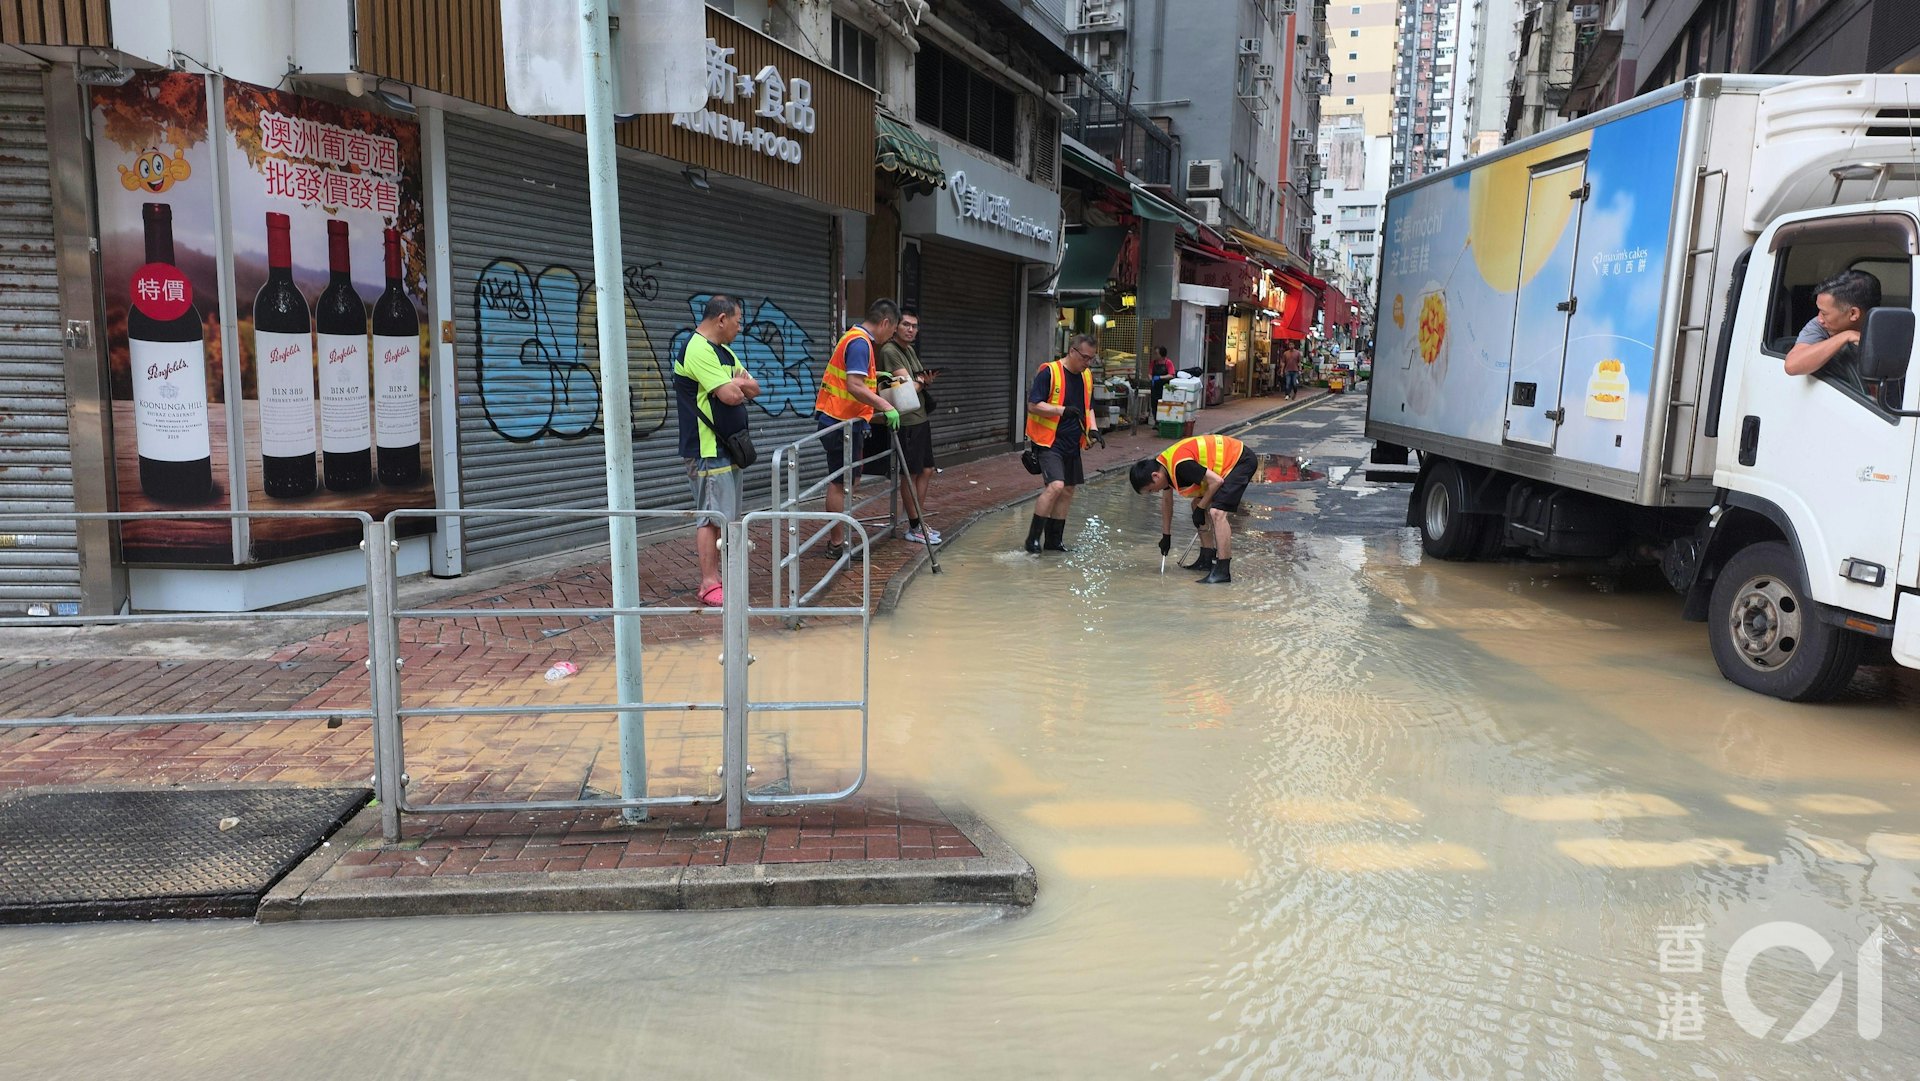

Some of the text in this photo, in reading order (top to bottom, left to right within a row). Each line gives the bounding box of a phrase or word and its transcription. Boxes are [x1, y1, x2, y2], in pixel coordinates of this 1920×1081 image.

[755, 65, 815, 134] 食品
[262, 113, 396, 173] 澳洲葡萄酒
[752, 127, 801, 165] FOOD
[266, 161, 398, 213] 批發價發售
[1628, 246, 1648, 260] cakes
[138, 278, 185, 302] 特價
[272, 388, 287, 396] BIN
[331, 386, 359, 394] BIN 407
[139, 400, 203, 410] KOONUNGA HILL
